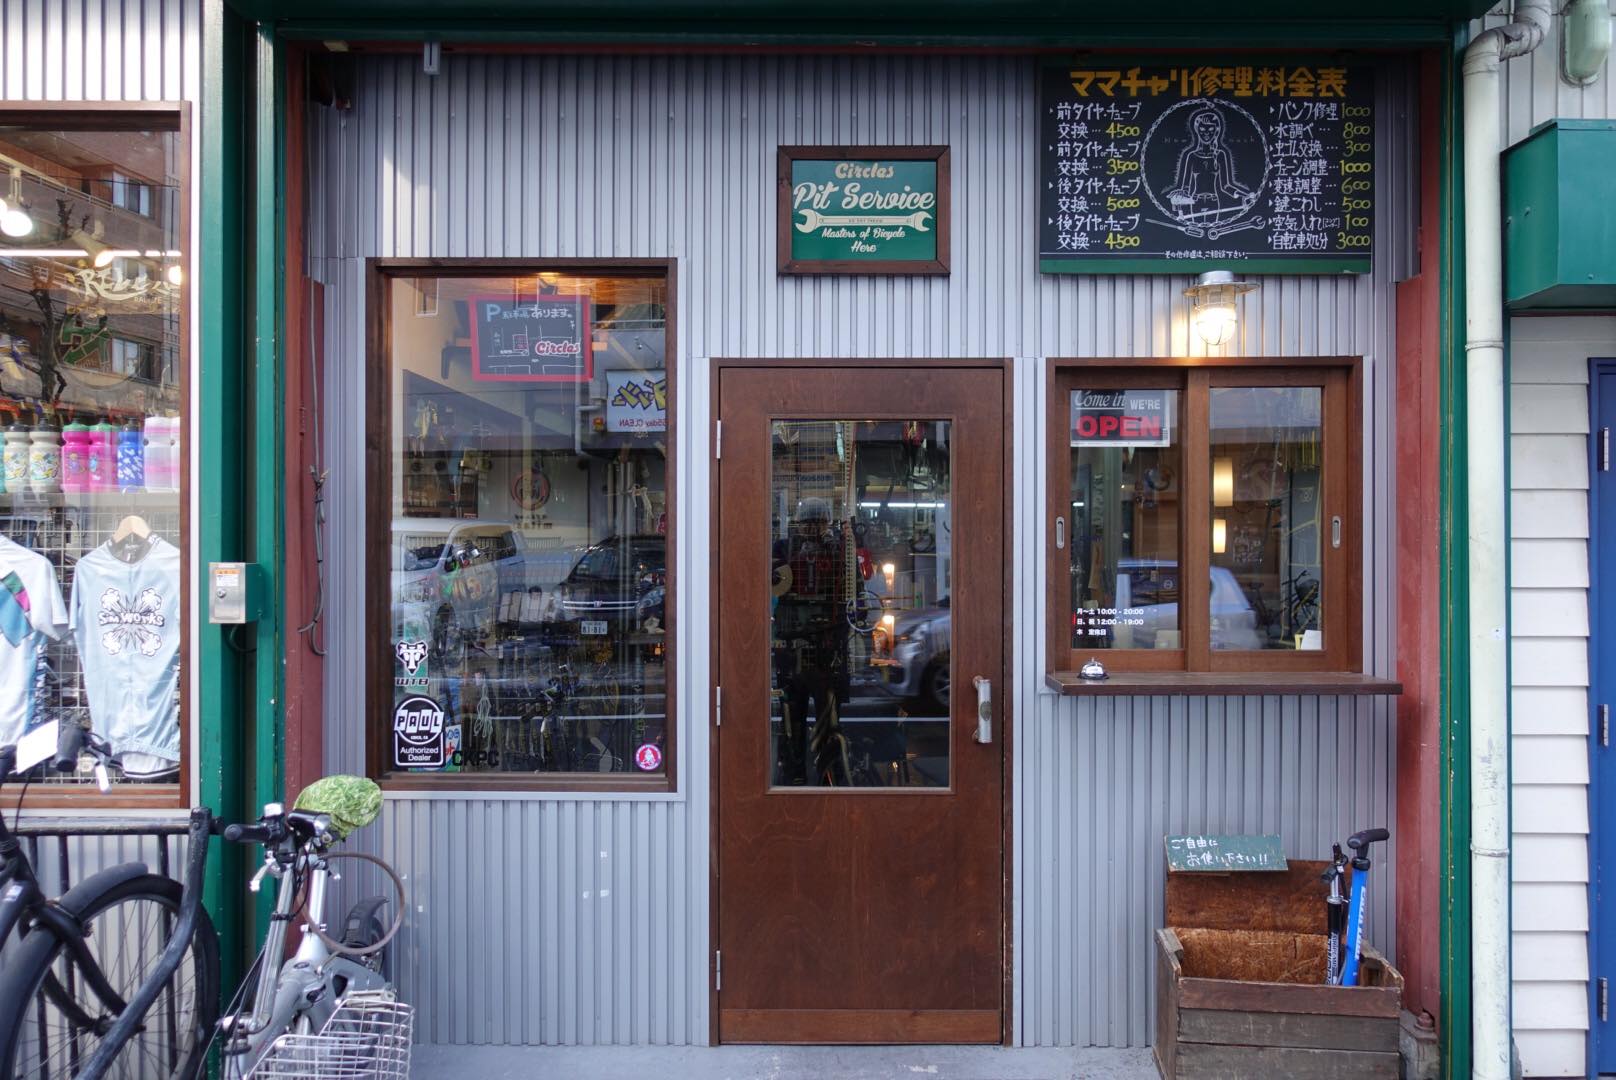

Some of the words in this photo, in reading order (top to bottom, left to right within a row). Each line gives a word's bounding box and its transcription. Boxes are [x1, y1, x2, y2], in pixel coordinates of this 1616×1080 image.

[1070, 66, 1347, 97] ママチャリ修理料金表
[1278, 101, 1339, 120] パンク修理
[1341, 102, 1371, 119] 1000
[1106, 122, 1140, 139] 4500
[1343, 122, 1370, 139] 800
[1343, 140, 1370, 157] 300
[835, 163, 894, 179] Circles
[1106, 158, 1139, 175] 3500
[1340, 159, 1371, 176] 1000
[1341, 177, 1370, 194] 600
[793, 181, 839, 210] Pit
[841, 182, 936, 210] Service
[1106, 196, 1140, 211] 5000
[1341, 196, 1371, 212] 500
[1344, 213, 1369, 231] 100
[821, 227, 856, 238] Masters
[859, 226, 870, 241] of
[873, 227, 906, 241] Bicycle
[1105, 232, 1140, 250] 4500
[1273, 231, 1328, 250] 自転車処分
[1336, 231, 1370, 250] 3000
[850, 241, 877, 253] Here
[535, 340, 581, 355] Circles
[1112, 392, 1126, 407] in
[1129, 399, 1161, 410] WE'RE
[1076, 415, 1161, 437] OPEN
[395, 677, 429, 686] WTB
[396, 713, 442, 729] PAUL
[400, 746, 439, 754] Authorized
[1171, 836, 1219, 850] ご自由に
